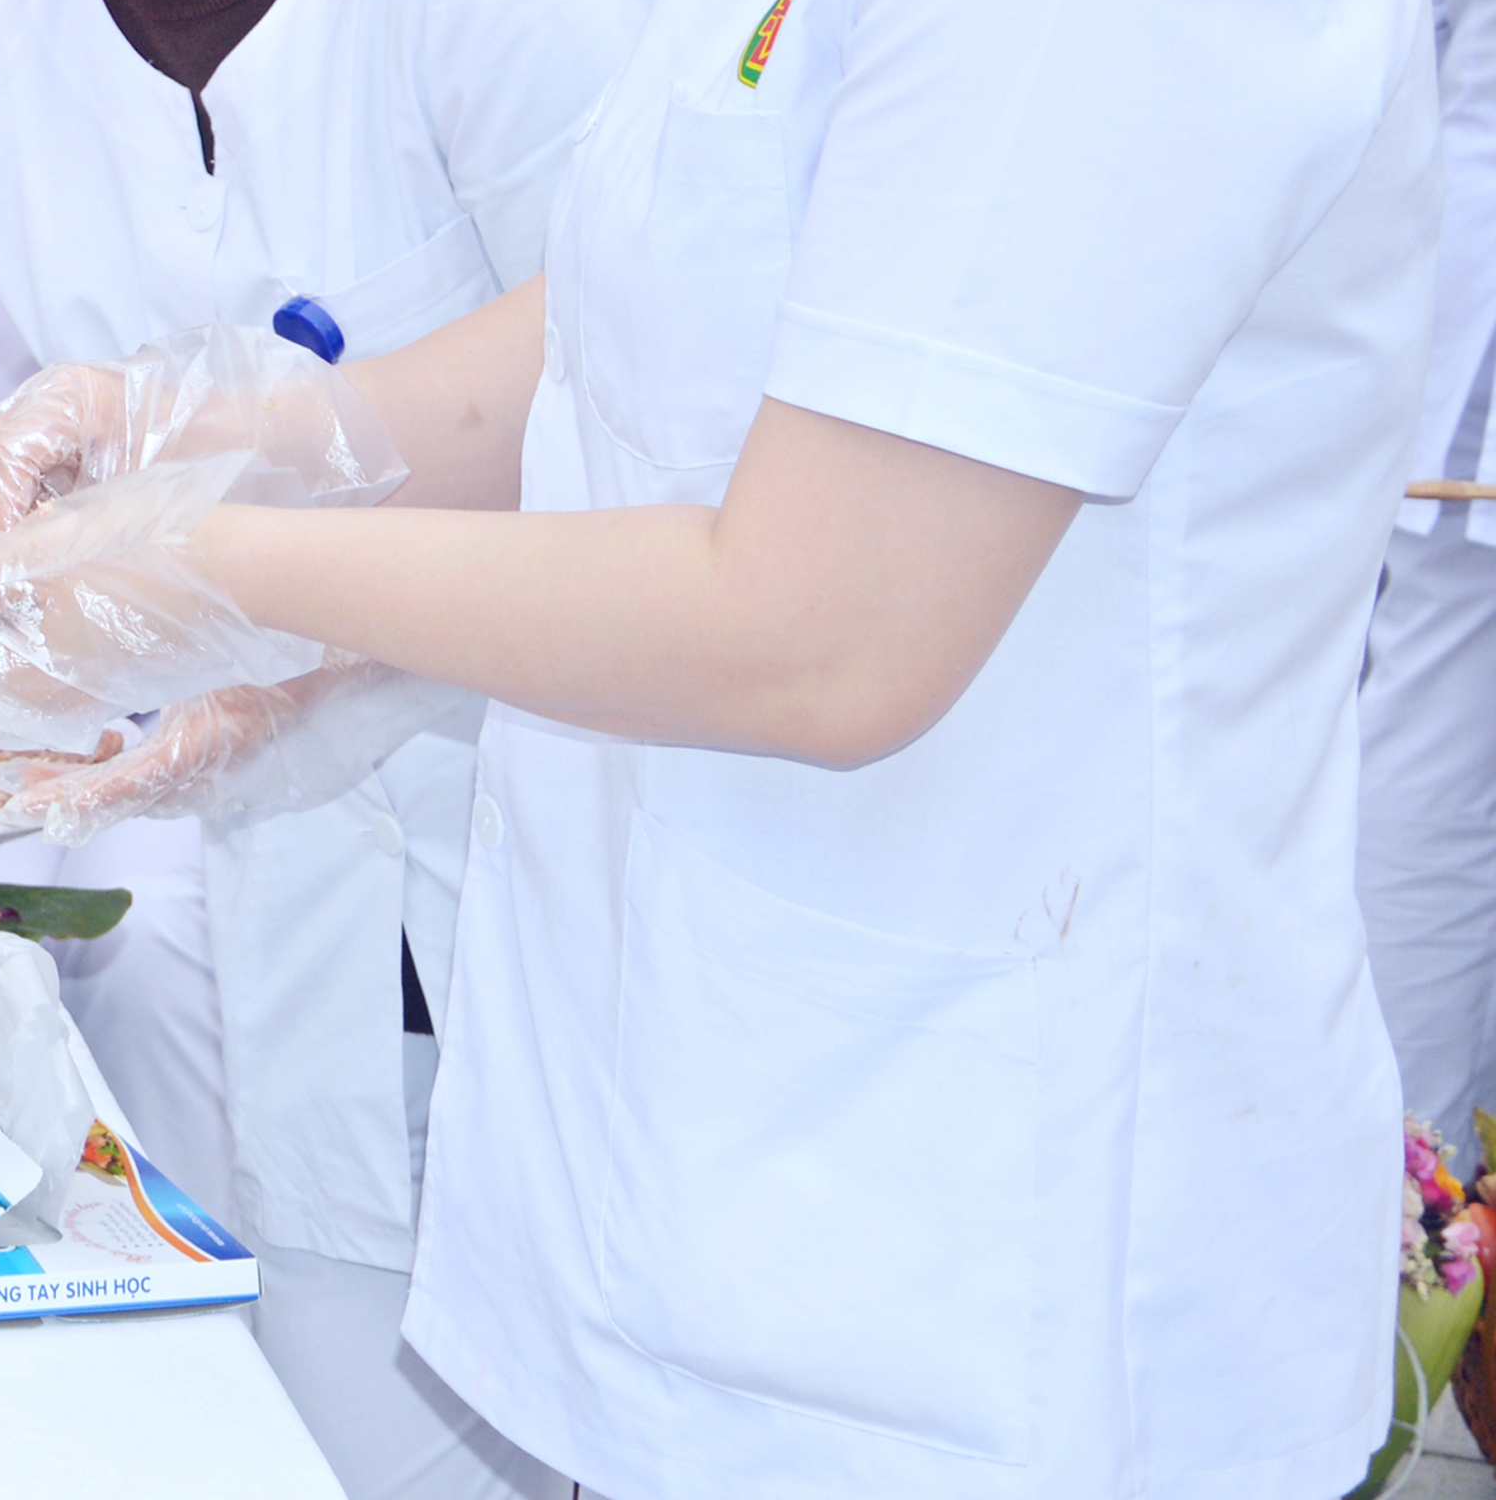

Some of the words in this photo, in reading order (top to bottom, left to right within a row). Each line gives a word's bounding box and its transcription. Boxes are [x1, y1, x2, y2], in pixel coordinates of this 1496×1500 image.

[28, 1284, 60, 1301] TAY
[66, 1280, 108, 1299] SINH
[114, 1276, 152, 1299] HỌC
